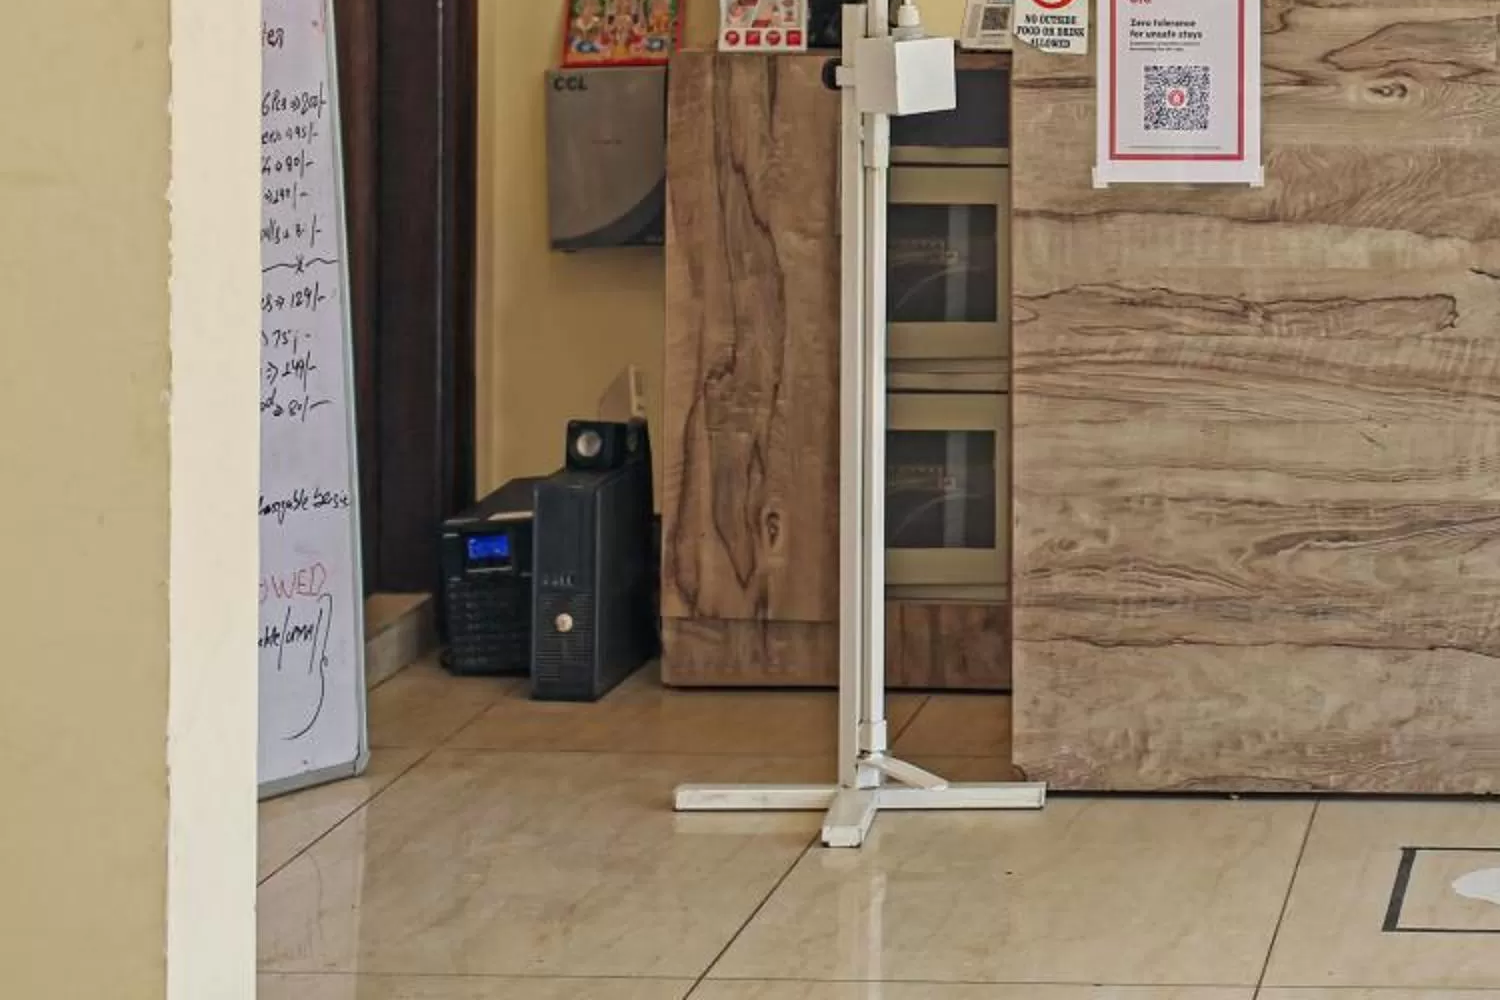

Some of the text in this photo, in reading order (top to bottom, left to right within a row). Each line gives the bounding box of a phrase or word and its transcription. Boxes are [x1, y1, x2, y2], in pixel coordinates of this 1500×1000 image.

[1025, 14, 1077, 24] NO OUTSIDE
[1130, 18, 1196, 27] Zero tolerance
[1017, 26, 1085, 36] FOOD OR DRINK
[1179, 30, 1203, 40] stays
[554, 75, 588, 91] CCL
